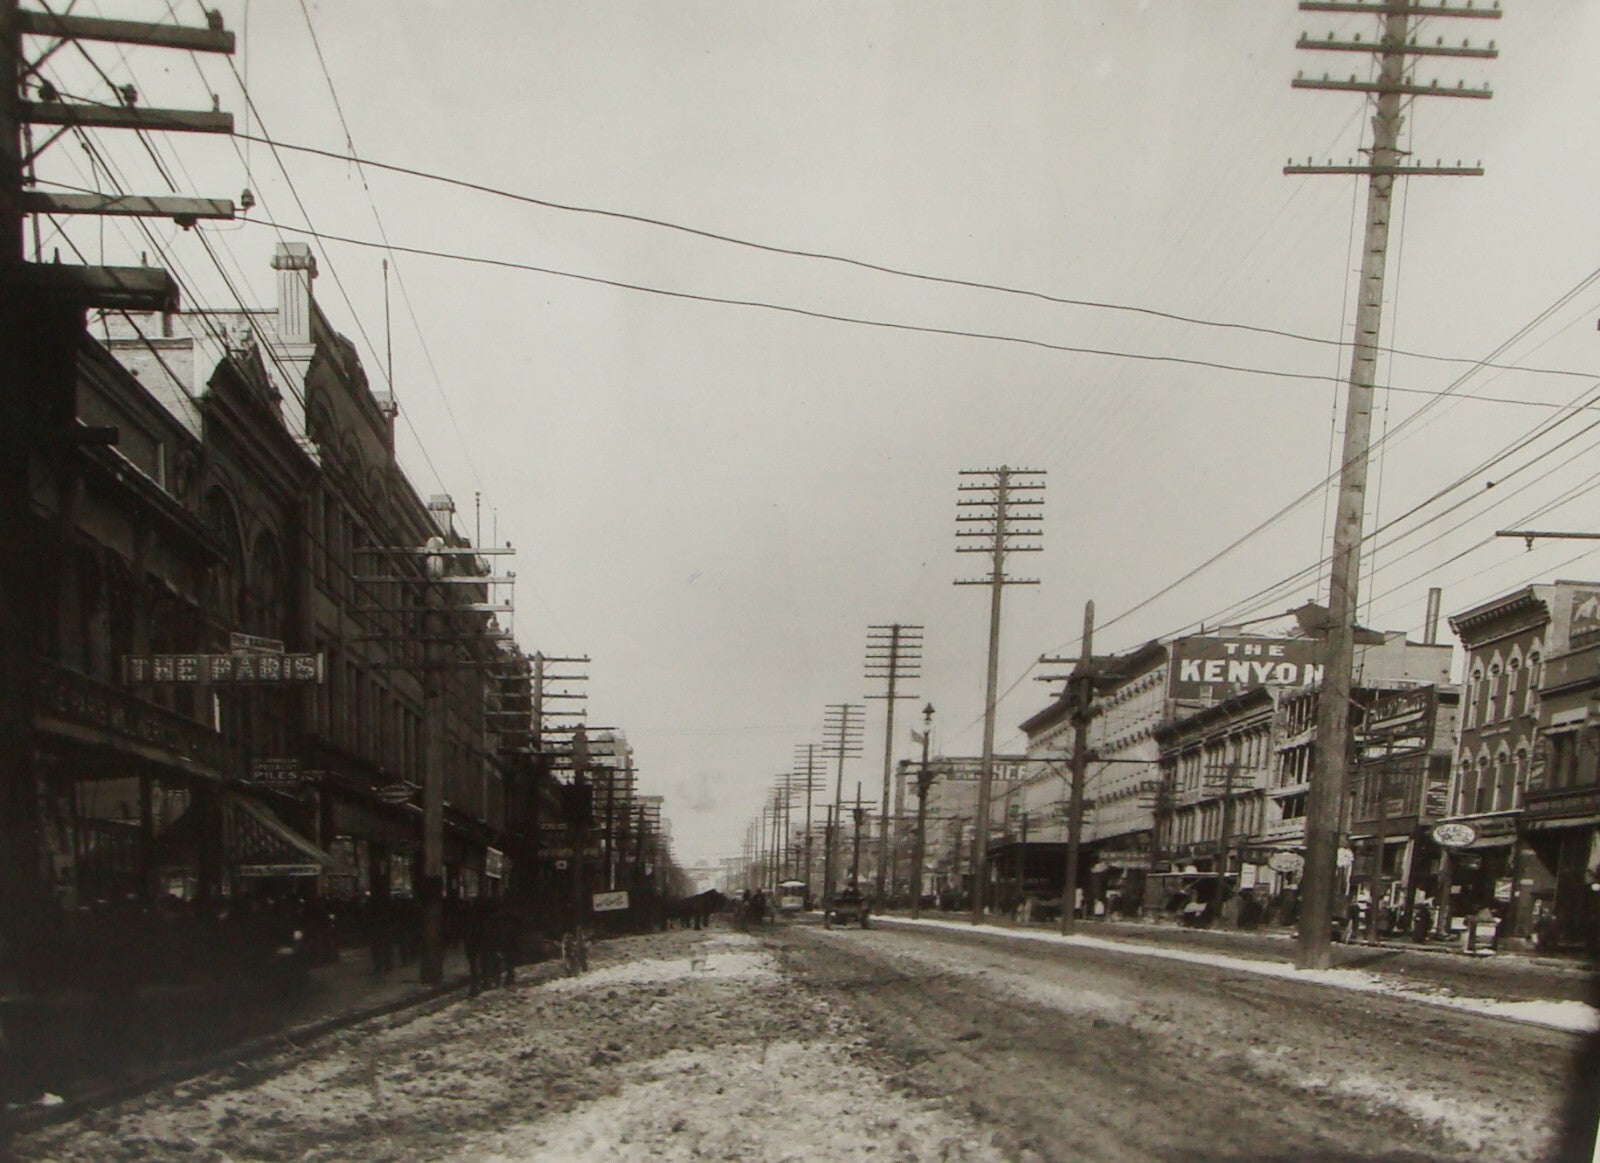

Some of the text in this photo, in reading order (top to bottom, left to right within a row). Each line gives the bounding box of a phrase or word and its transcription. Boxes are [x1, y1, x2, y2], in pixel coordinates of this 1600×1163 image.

[1223, 643, 1285, 657] THE
[131, 656, 316, 682] THE PARIS
[1180, 659, 1325, 686] KENYON
